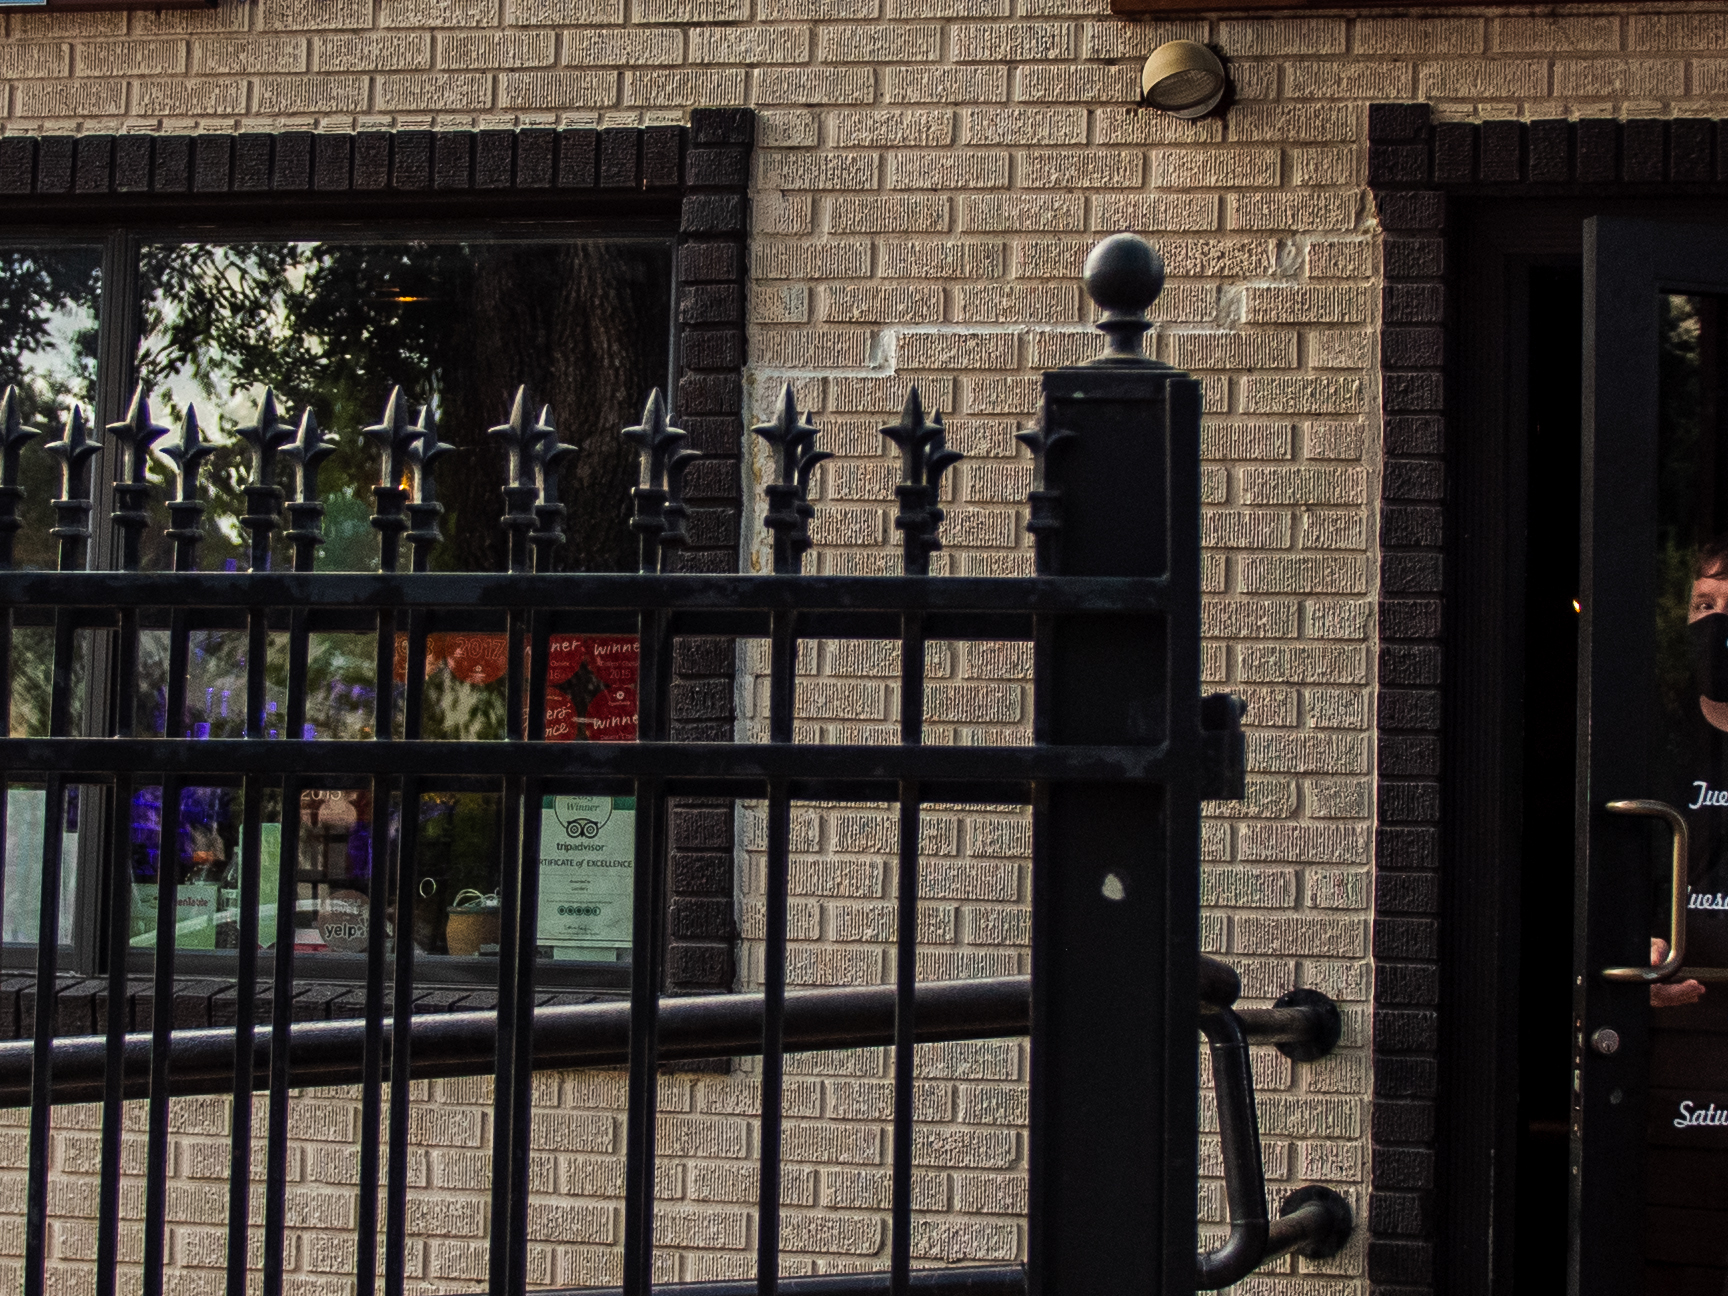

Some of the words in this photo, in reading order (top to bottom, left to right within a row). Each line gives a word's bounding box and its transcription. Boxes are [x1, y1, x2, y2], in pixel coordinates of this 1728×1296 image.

[456, 636, 507, 660] 2017
[593, 641, 640, 656] winne
[593, 713, 639, 730] winne
[567, 802, 601, 812] Winner
[556, 841, 606, 853] tripadvisor
[539, 858, 574, 868] RTIFICATE
[575, 858, 585, 869] of
[586, 859, 633, 869] EXCELLENCE
[324, 923, 358, 940] yelp
